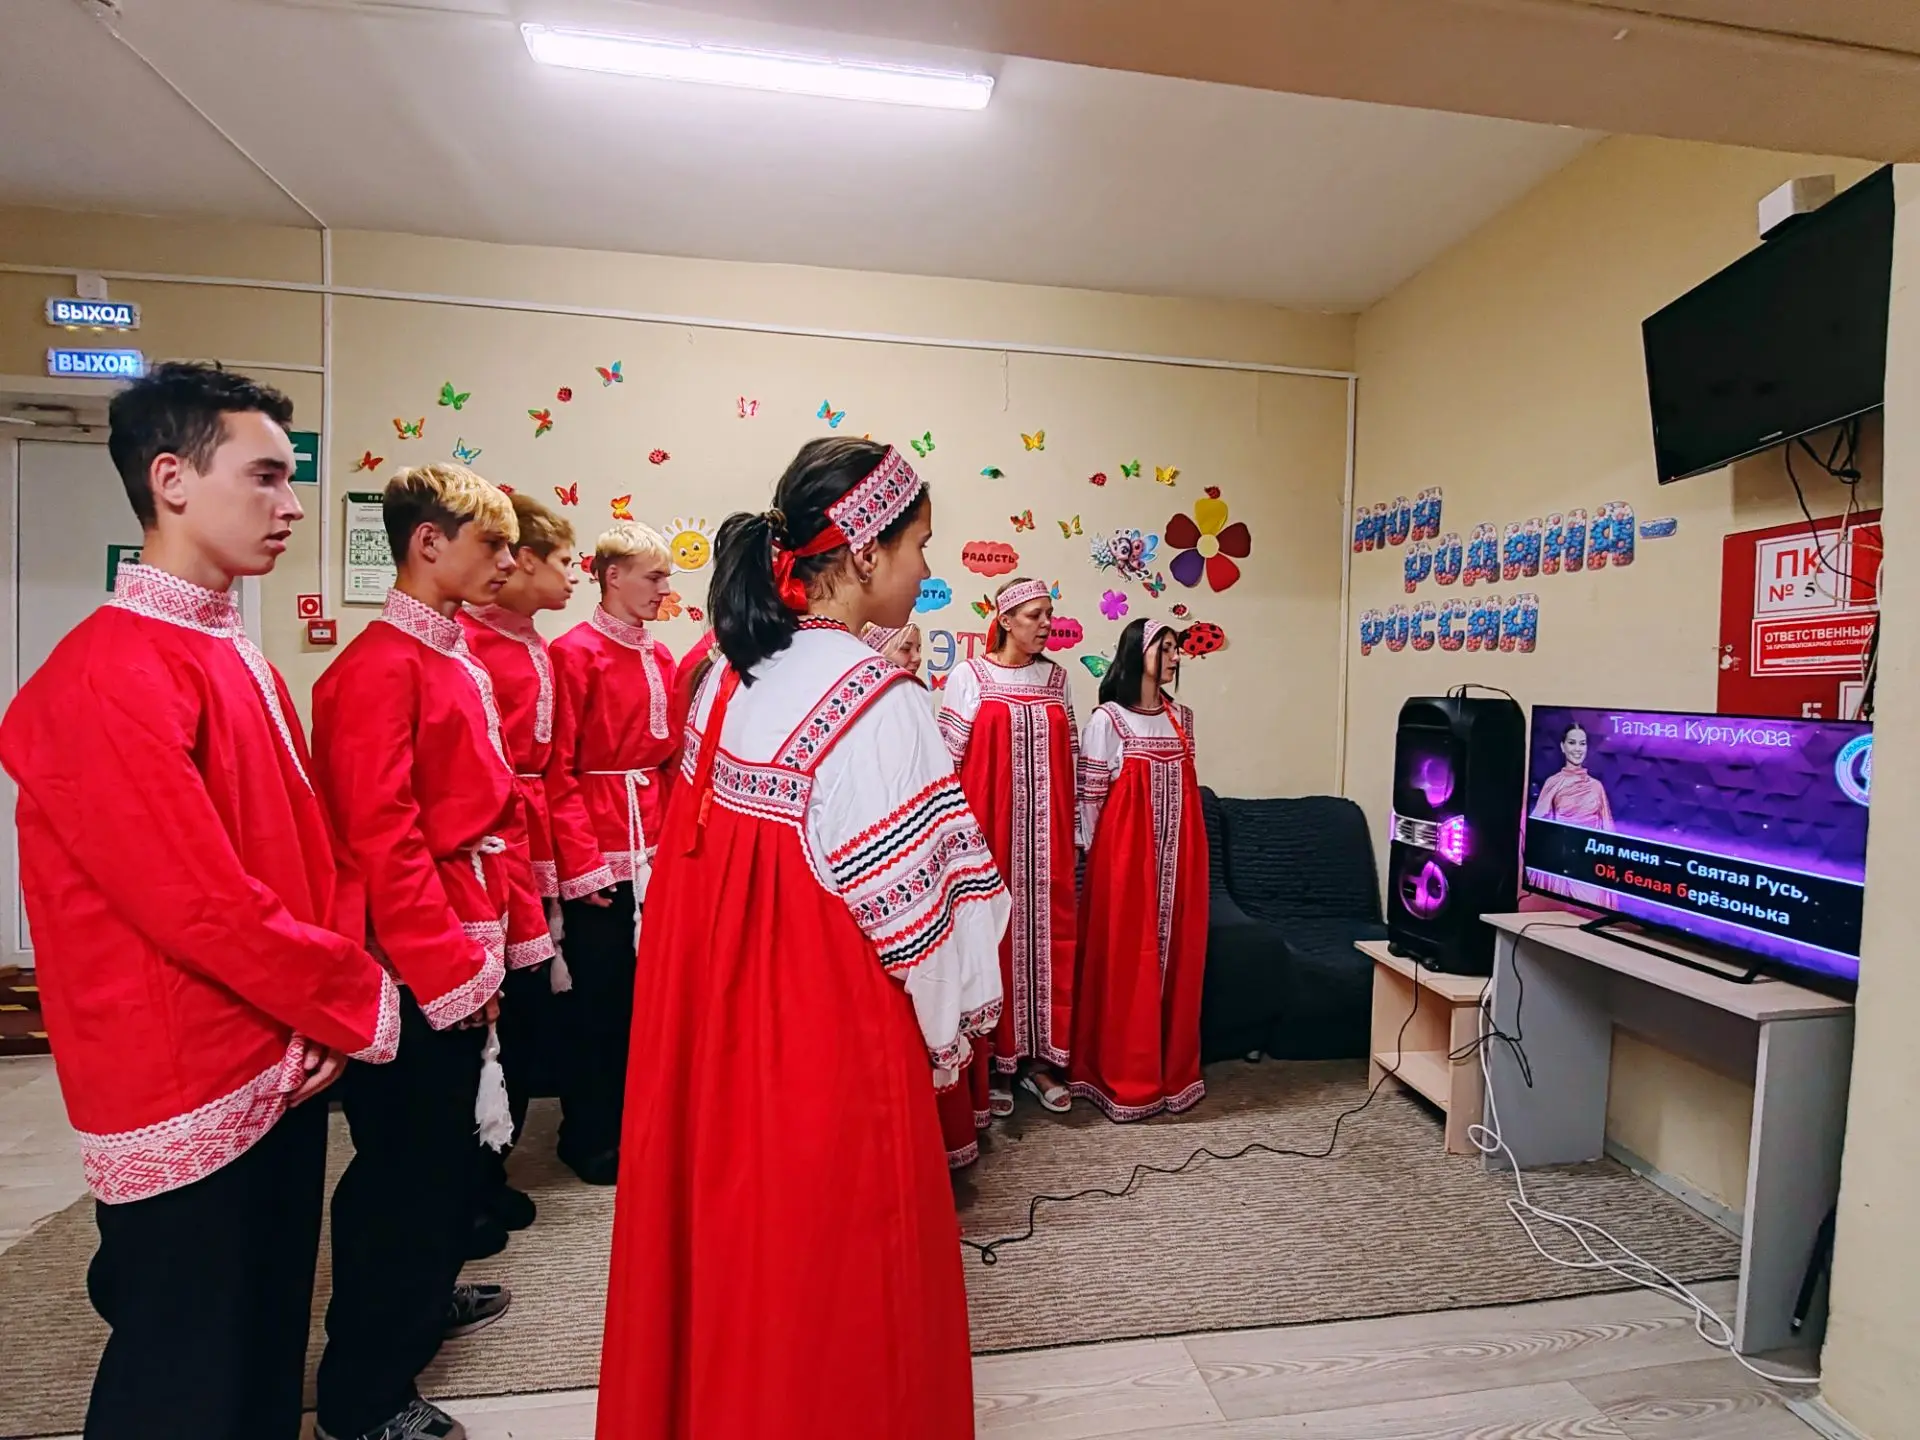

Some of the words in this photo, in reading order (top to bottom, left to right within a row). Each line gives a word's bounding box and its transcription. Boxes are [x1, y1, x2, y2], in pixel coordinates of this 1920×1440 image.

[56, 303, 131, 323] ВЫХОД
[57, 353, 134, 374] ВЫХОД
[1353, 486, 1443, 553] МОЯ
[962, 551, 1016, 564] РАДОСТЬ
[1775, 544, 1825, 579] ПК
[922, 588, 947, 599] ОТА
[1768, 583, 1795, 602] №
[1803, 582, 1816, 598] 5
[1050, 628, 1079, 638] БОВЬ
[1359, 593, 1540, 657] РОССИЯ
[1764, 622, 1876, 643] ОТВЕТСТВЕННЫЙ
[1610, 716, 1678, 738] Татьяна
[1685, 720, 1792, 747] Куртукова
[1584, 838, 1614, 855] Для
[1617, 848, 1660, 866] меня
[1687, 859, 1750, 887] Святая
[1755, 874, 1809, 903] Русь,
[1594, 863, 1620, 883] Ой,
[1624, 871, 1672, 895] белая
[1676, 883, 1790, 925] берёзонька
